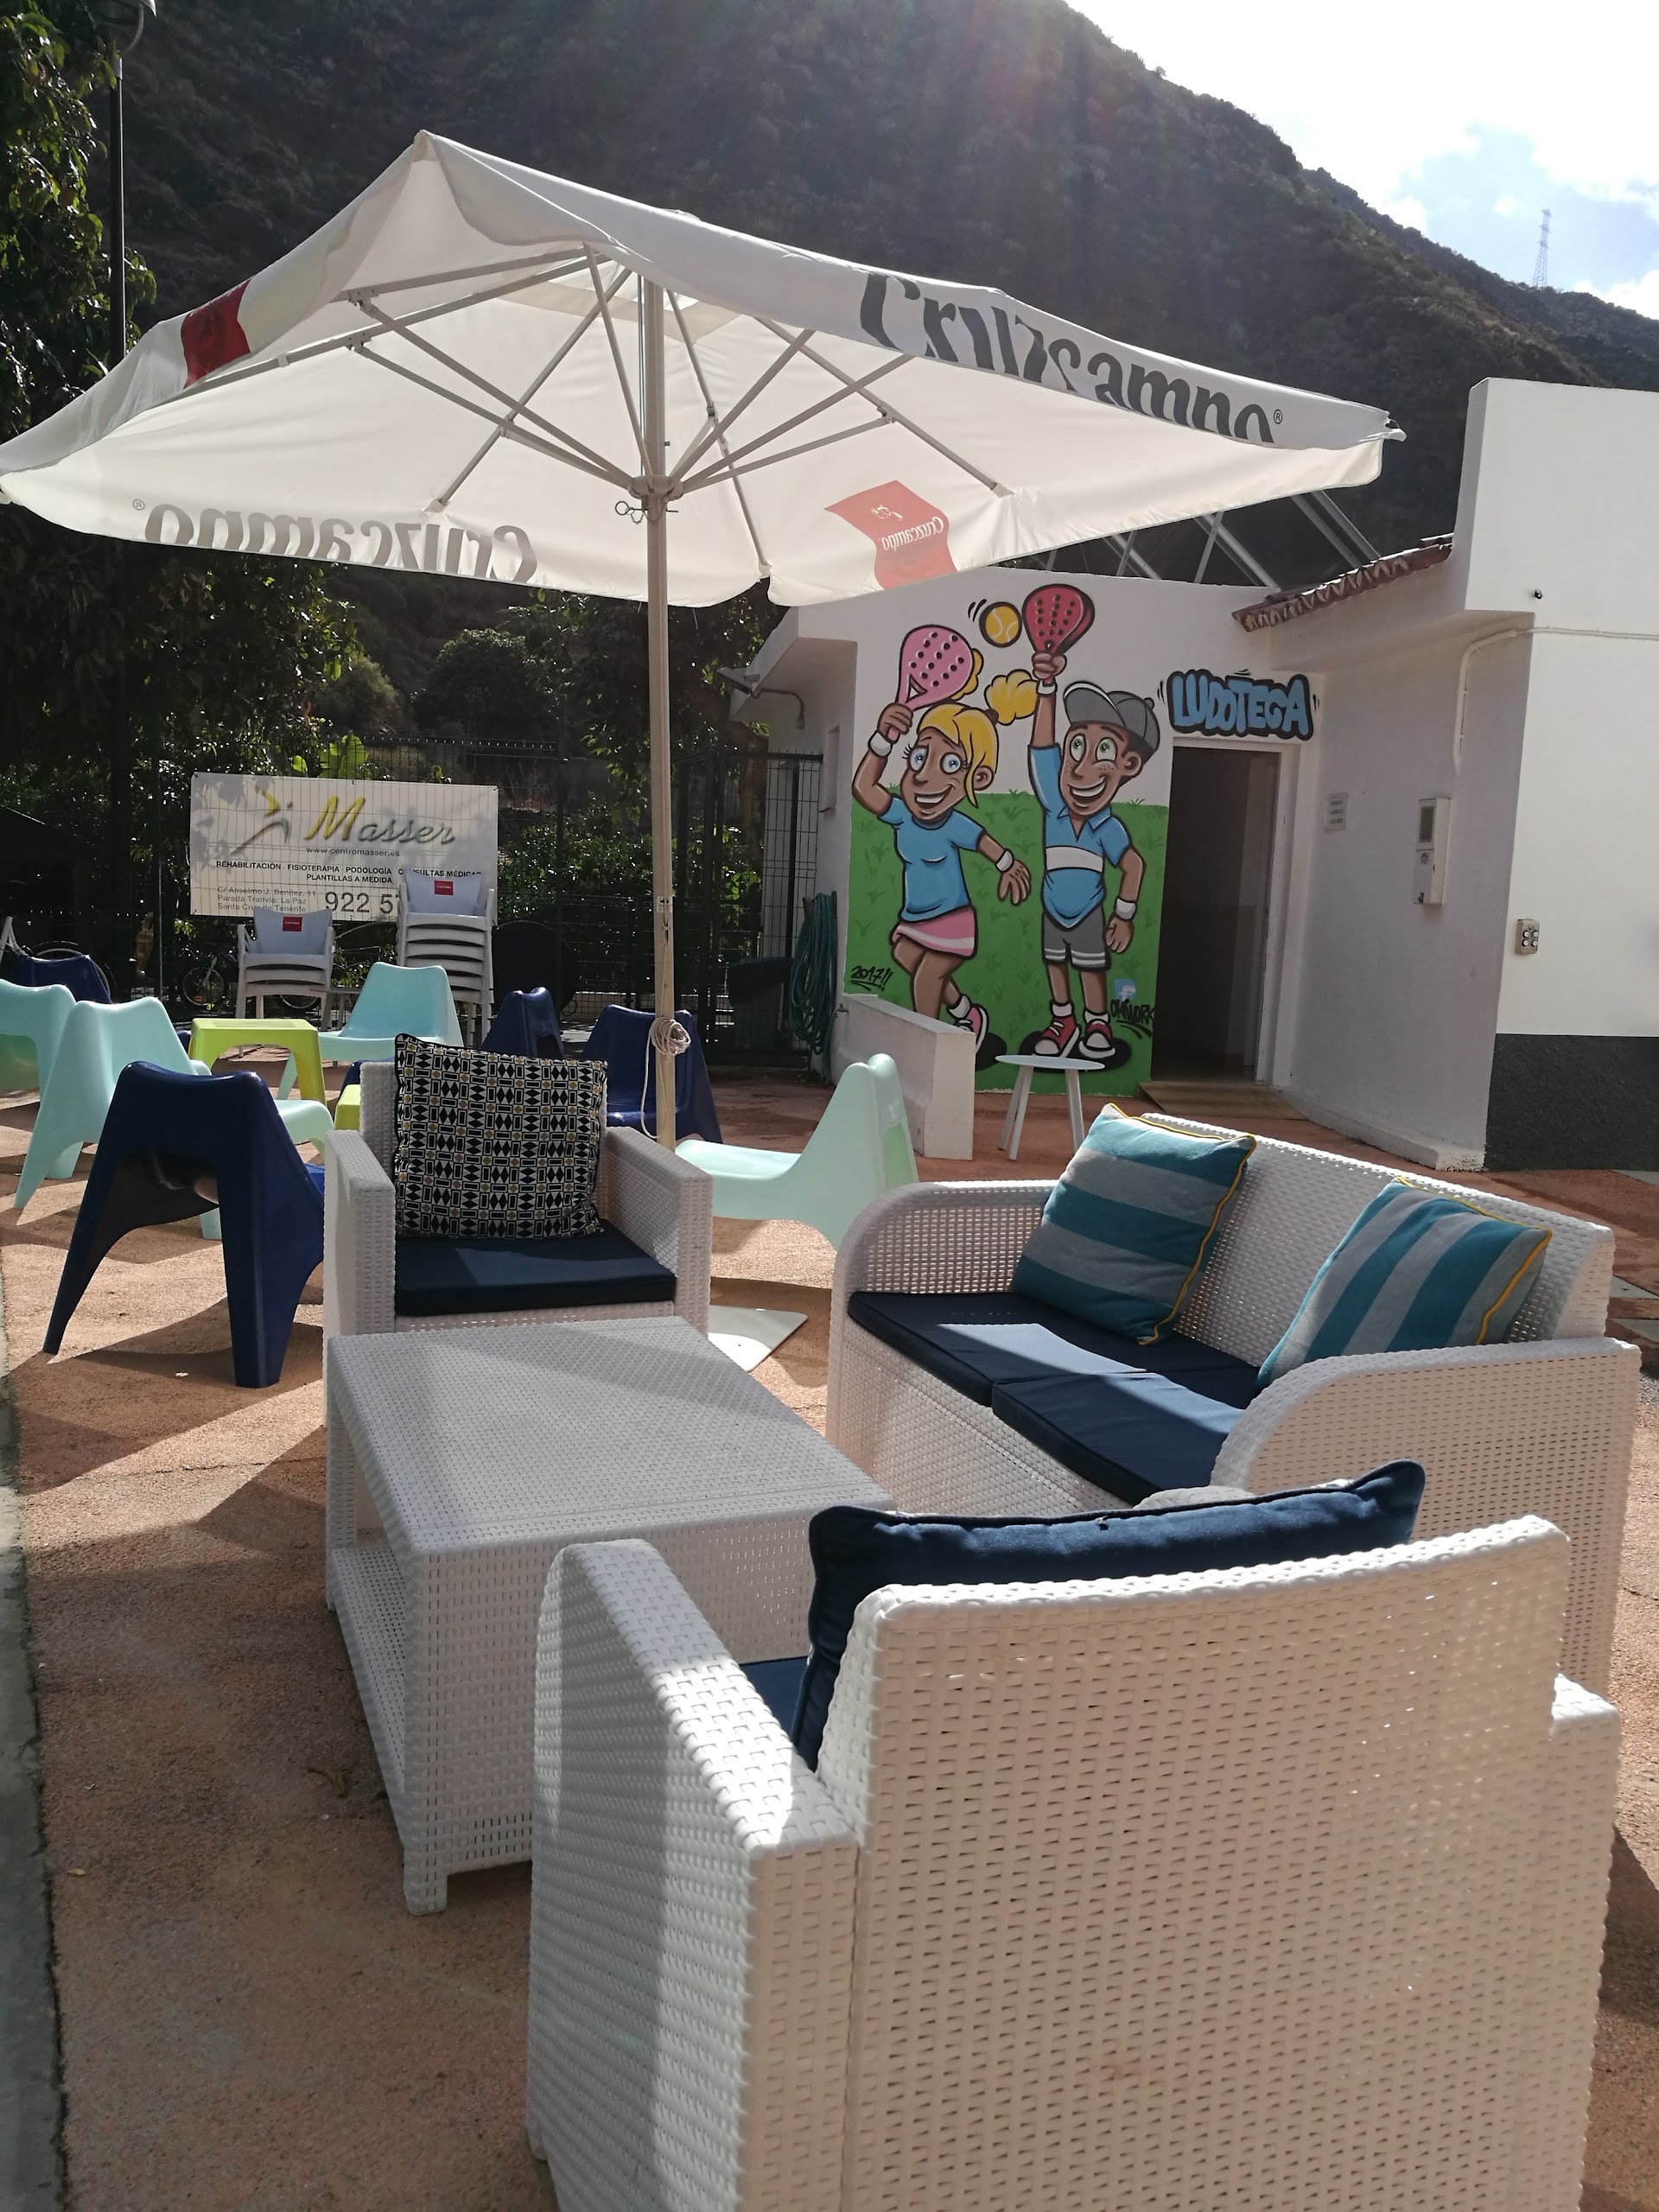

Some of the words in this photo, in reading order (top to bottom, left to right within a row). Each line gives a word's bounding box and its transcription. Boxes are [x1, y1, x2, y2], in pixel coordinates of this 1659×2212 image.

[1169, 671, 1312, 739] LUDOTECA
[304, 794, 455, 845] Masser
[306, 846, 400, 857] www.centromasser.es
[216, 861, 282, 870] REHABILITACIÓN
[287, 863, 340, 873] FISIOTERAPIA
[346, 866, 392, 874] PODOLOGÍA
[306, 874, 353, 882] PLANTILLAS
[361, 875, 393, 884] MEDIDA
[274, 904, 306, 912] Tenerife
[325, 891, 370, 913] 922
[379, 893, 398, 914] 5
